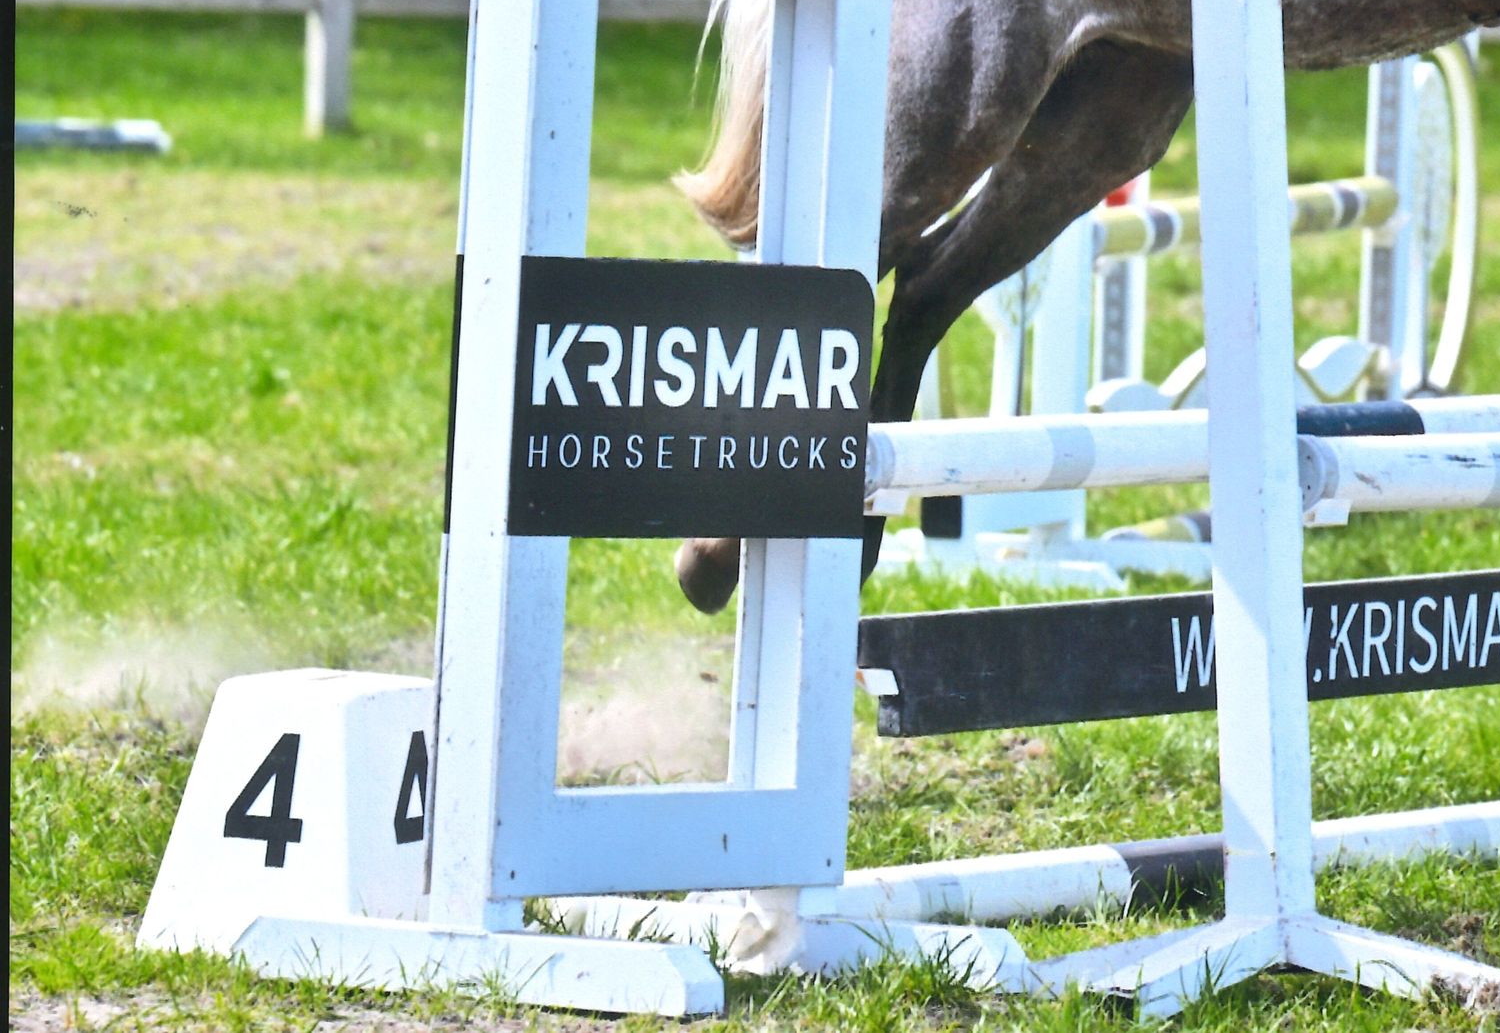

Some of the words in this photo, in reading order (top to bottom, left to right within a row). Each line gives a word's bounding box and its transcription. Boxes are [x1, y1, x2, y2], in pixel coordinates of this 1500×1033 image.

[531, 323, 861, 410] KRISMAR
[527, 433, 858, 469] HORSETRUCKS
[223, 733, 303, 868] 4
